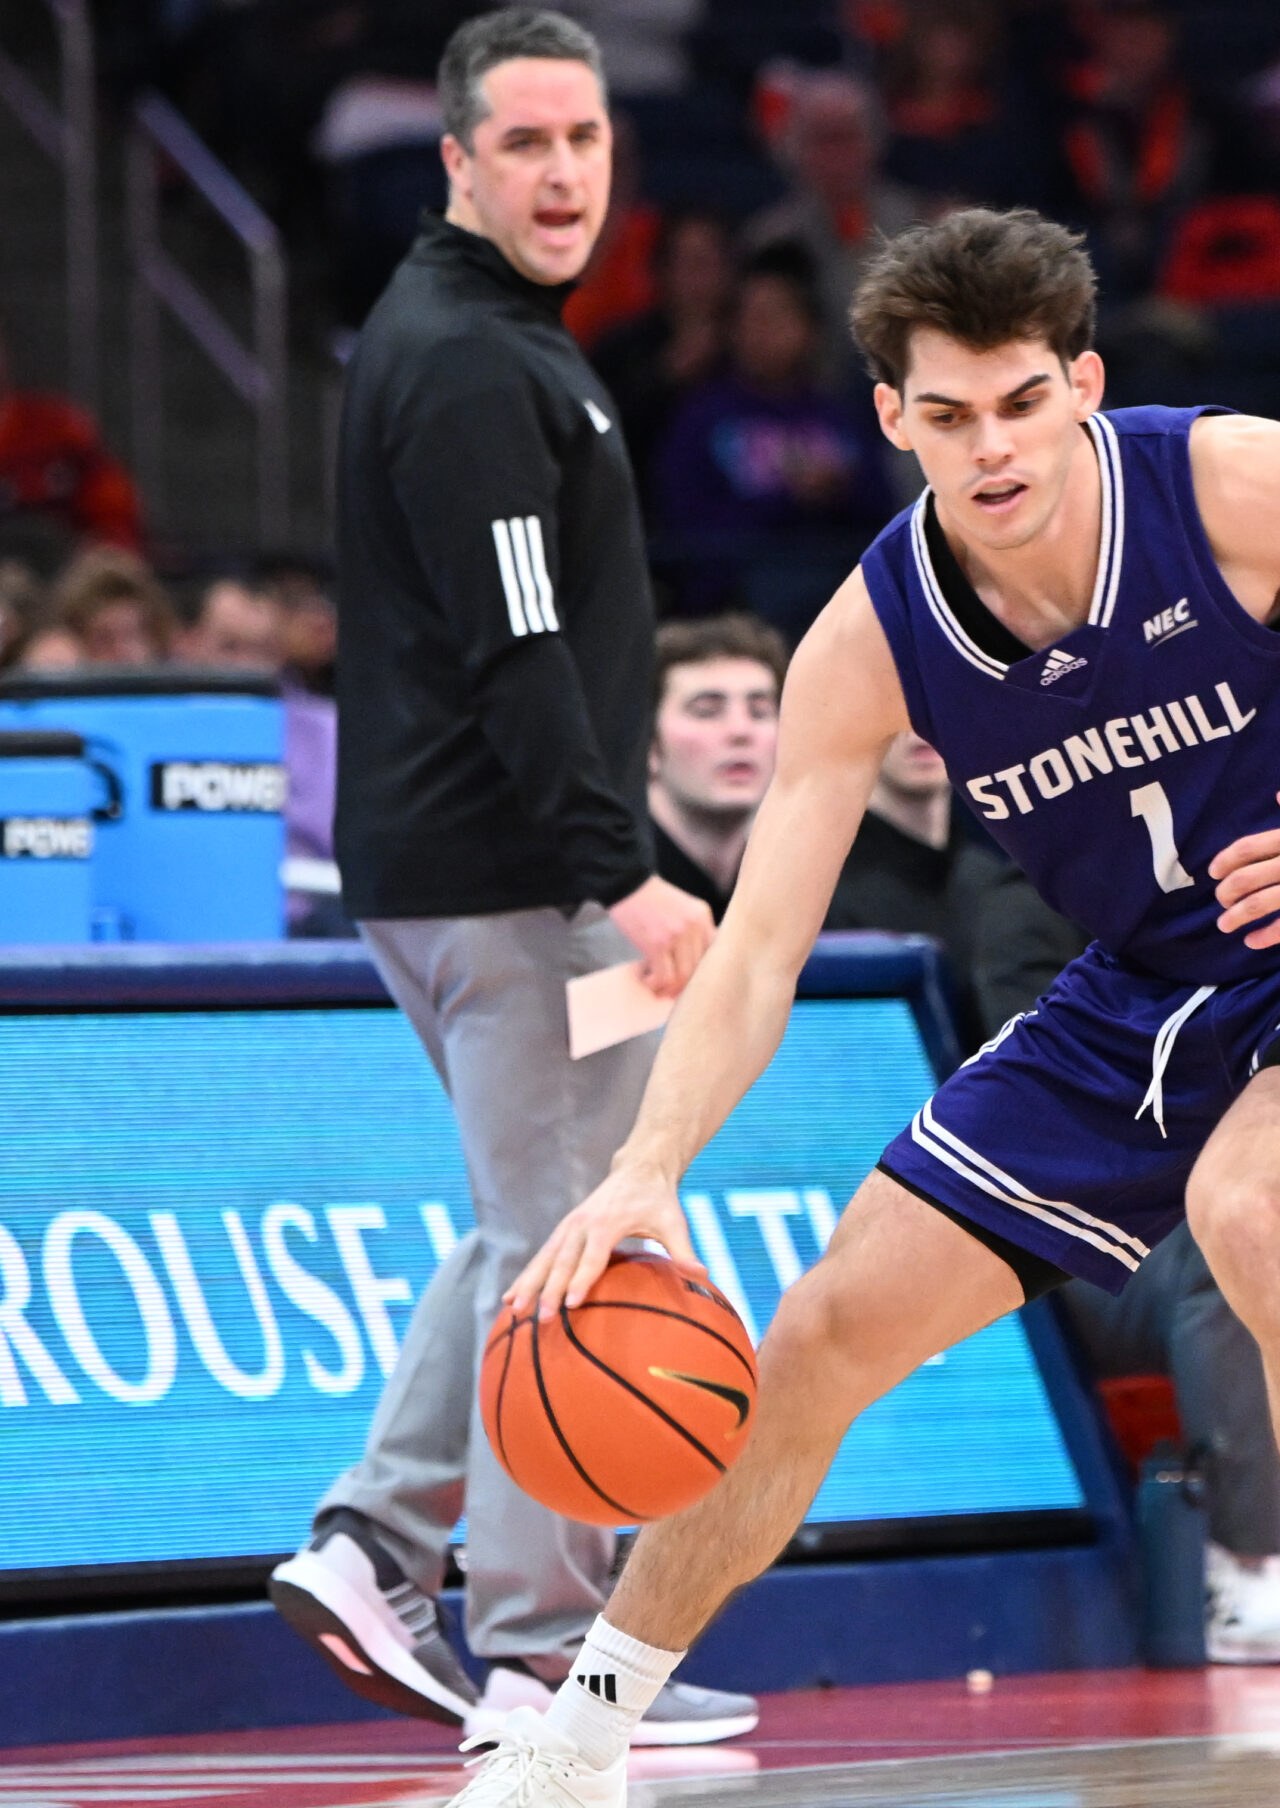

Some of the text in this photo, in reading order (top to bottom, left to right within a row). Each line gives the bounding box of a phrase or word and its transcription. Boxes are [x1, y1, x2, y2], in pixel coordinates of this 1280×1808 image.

[1143, 597, 1191, 644] NEC
[1040, 657, 1088, 686] adidas
[966, 681, 1257, 820] STONEHILL
[1129, 781, 1196, 894] 1
